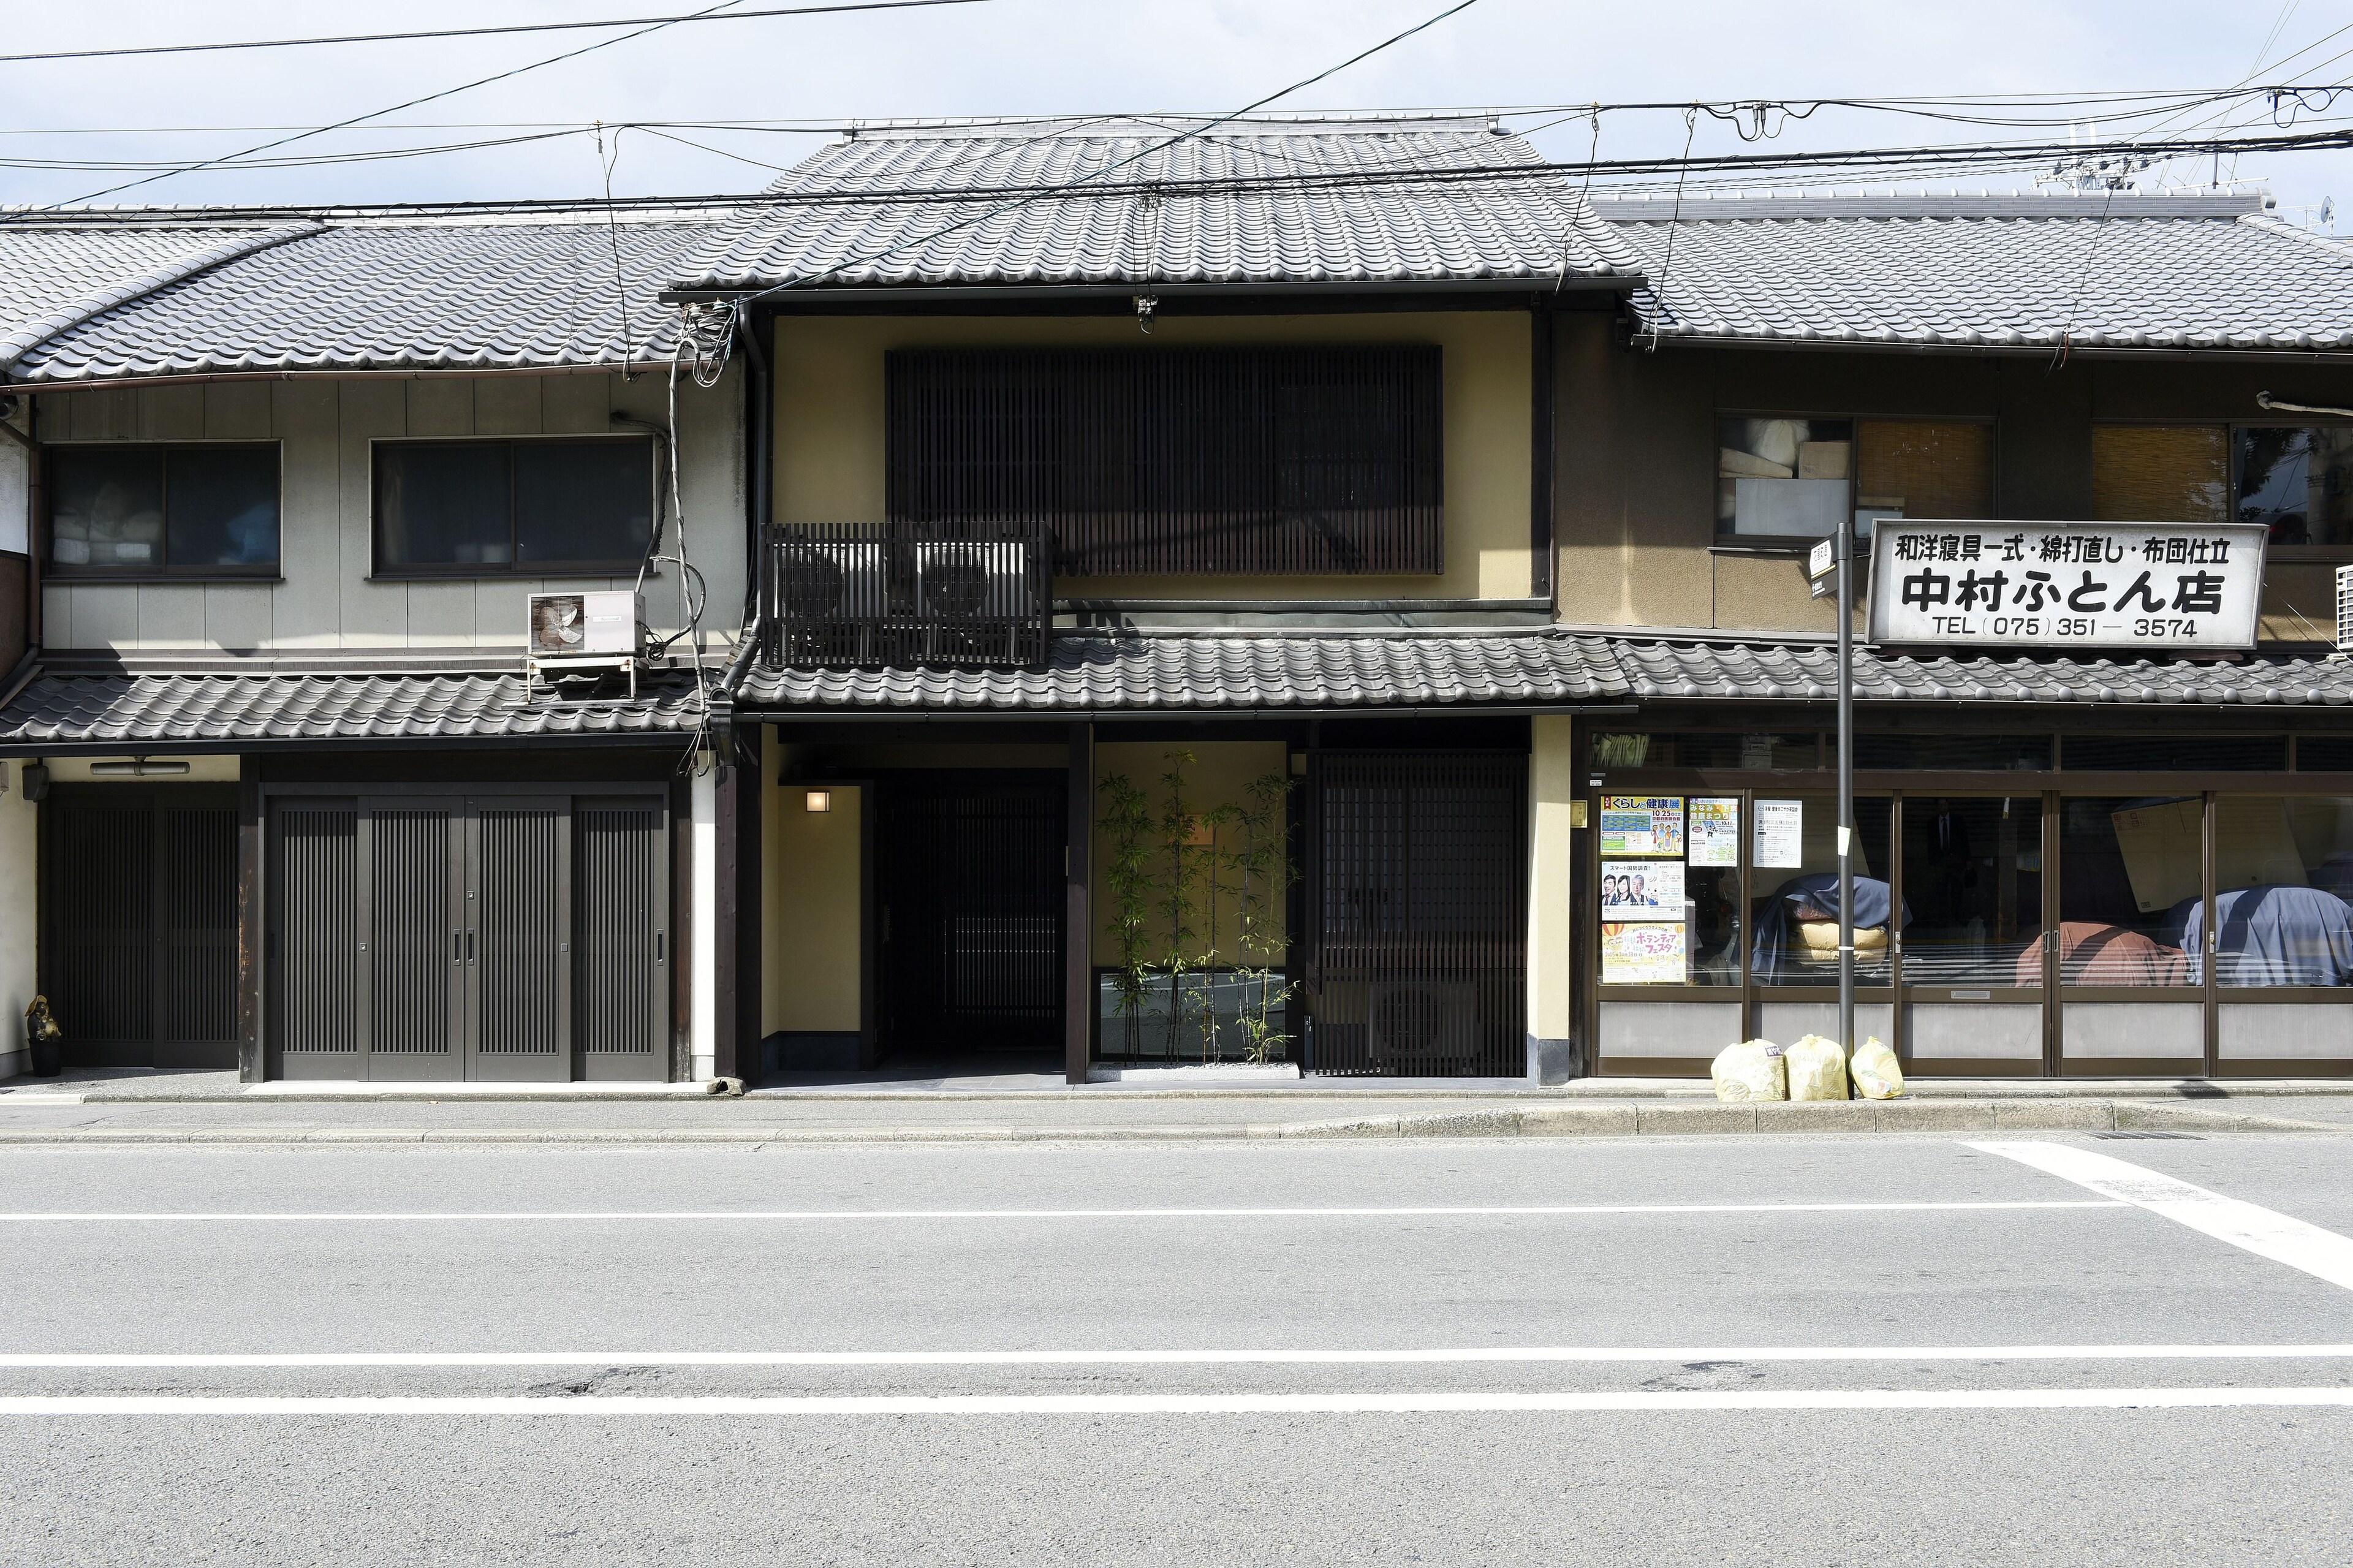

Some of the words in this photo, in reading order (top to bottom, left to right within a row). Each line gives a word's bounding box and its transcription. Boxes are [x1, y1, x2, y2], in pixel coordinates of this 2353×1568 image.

[1902, 567, 2225, 615] 中村ふとん店
[1613, 798, 1680, 809] くらしと健康展
[1637, 932, 1677, 944] ボランティア
[1645, 944, 1672, 954] フェスタ
